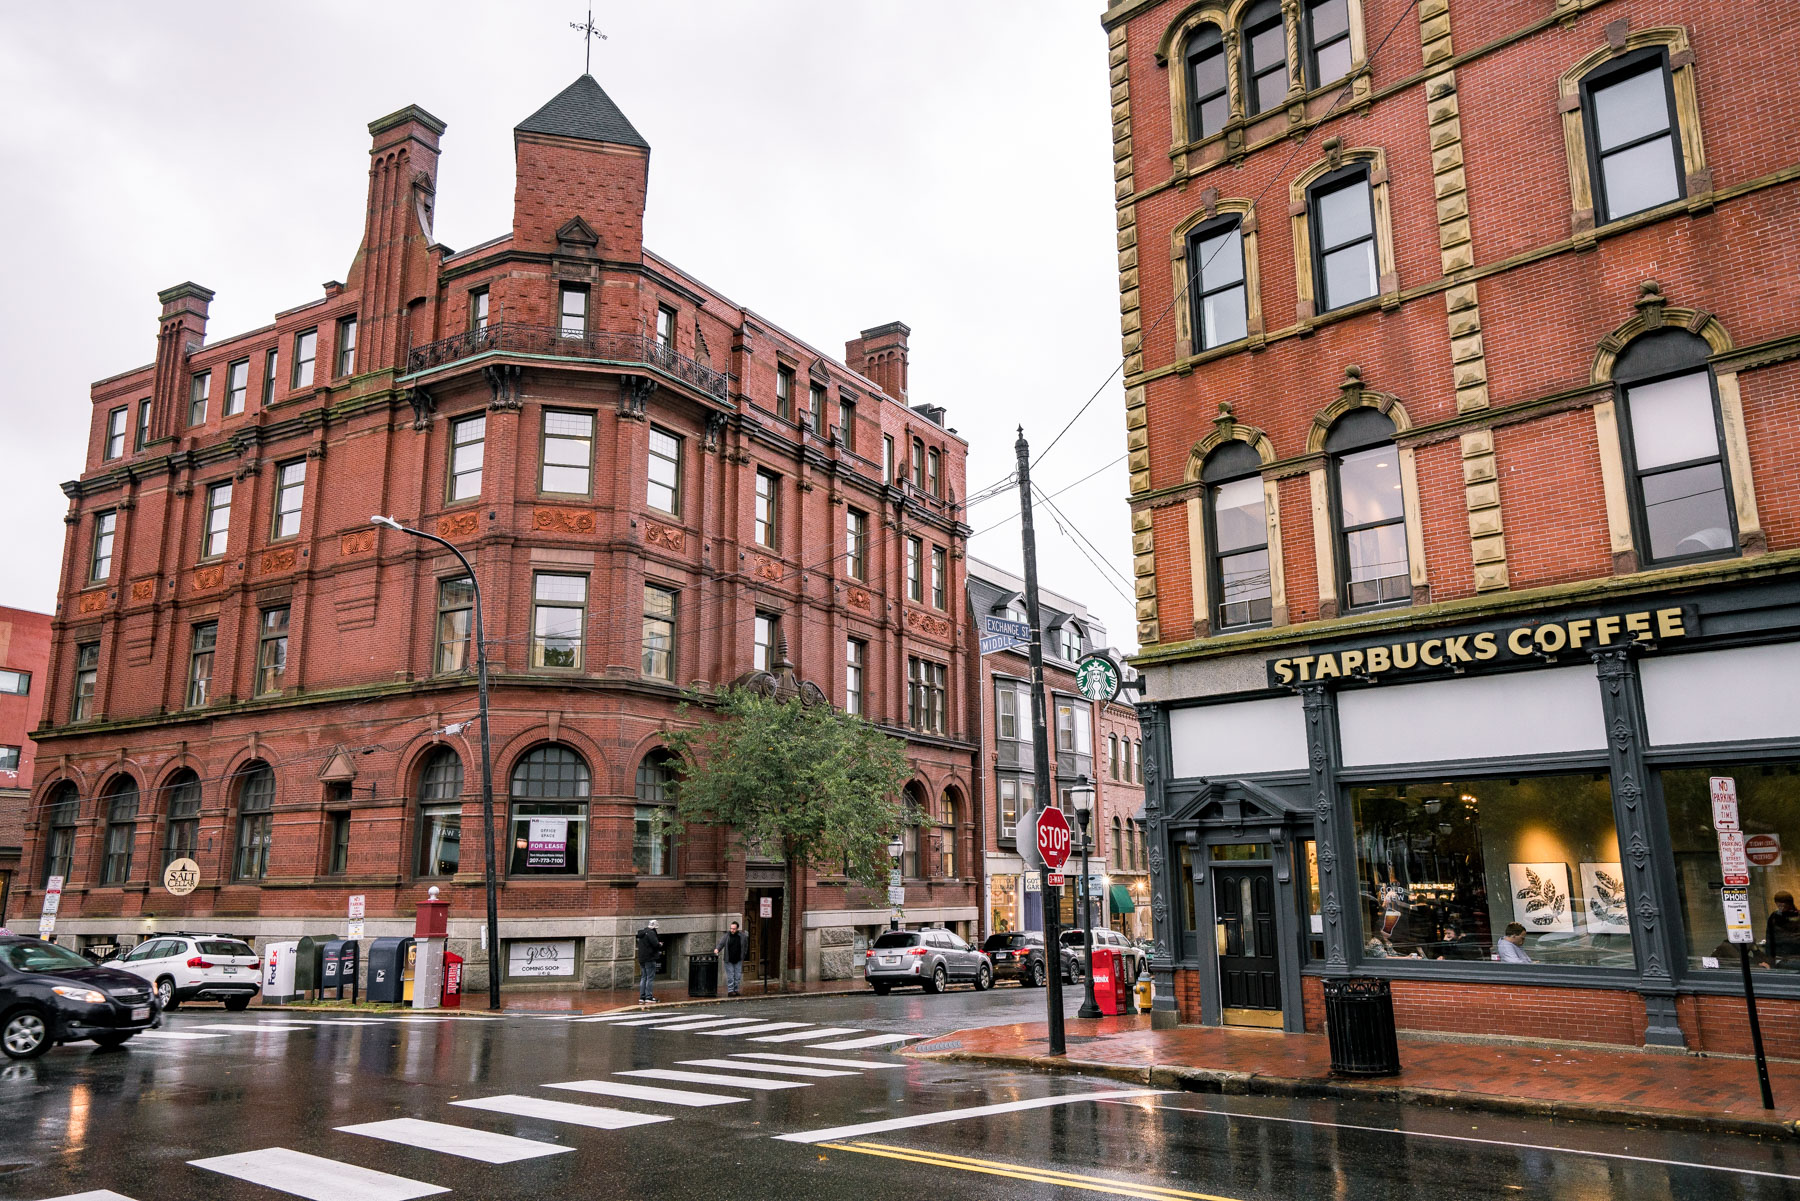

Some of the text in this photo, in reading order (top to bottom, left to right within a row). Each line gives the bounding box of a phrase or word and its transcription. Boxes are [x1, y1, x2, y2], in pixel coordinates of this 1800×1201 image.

[987, 619, 1029, 638] EXCHANGE ST
[982, 636, 1012, 652] MIDDLE
[1274, 607, 1686, 684] STARBUCKS COFFEE
[1718, 782, 1728, 792] NO
[1713, 793, 1735, 803] PARKING
[1039, 825, 1068, 850] STOP
[169, 871, 197, 881] SALT
[1049, 876, 1064, 884] 3-WAY
[168, 879, 195, 887] CELLAR
[267, 950, 278, 985] FedEx
